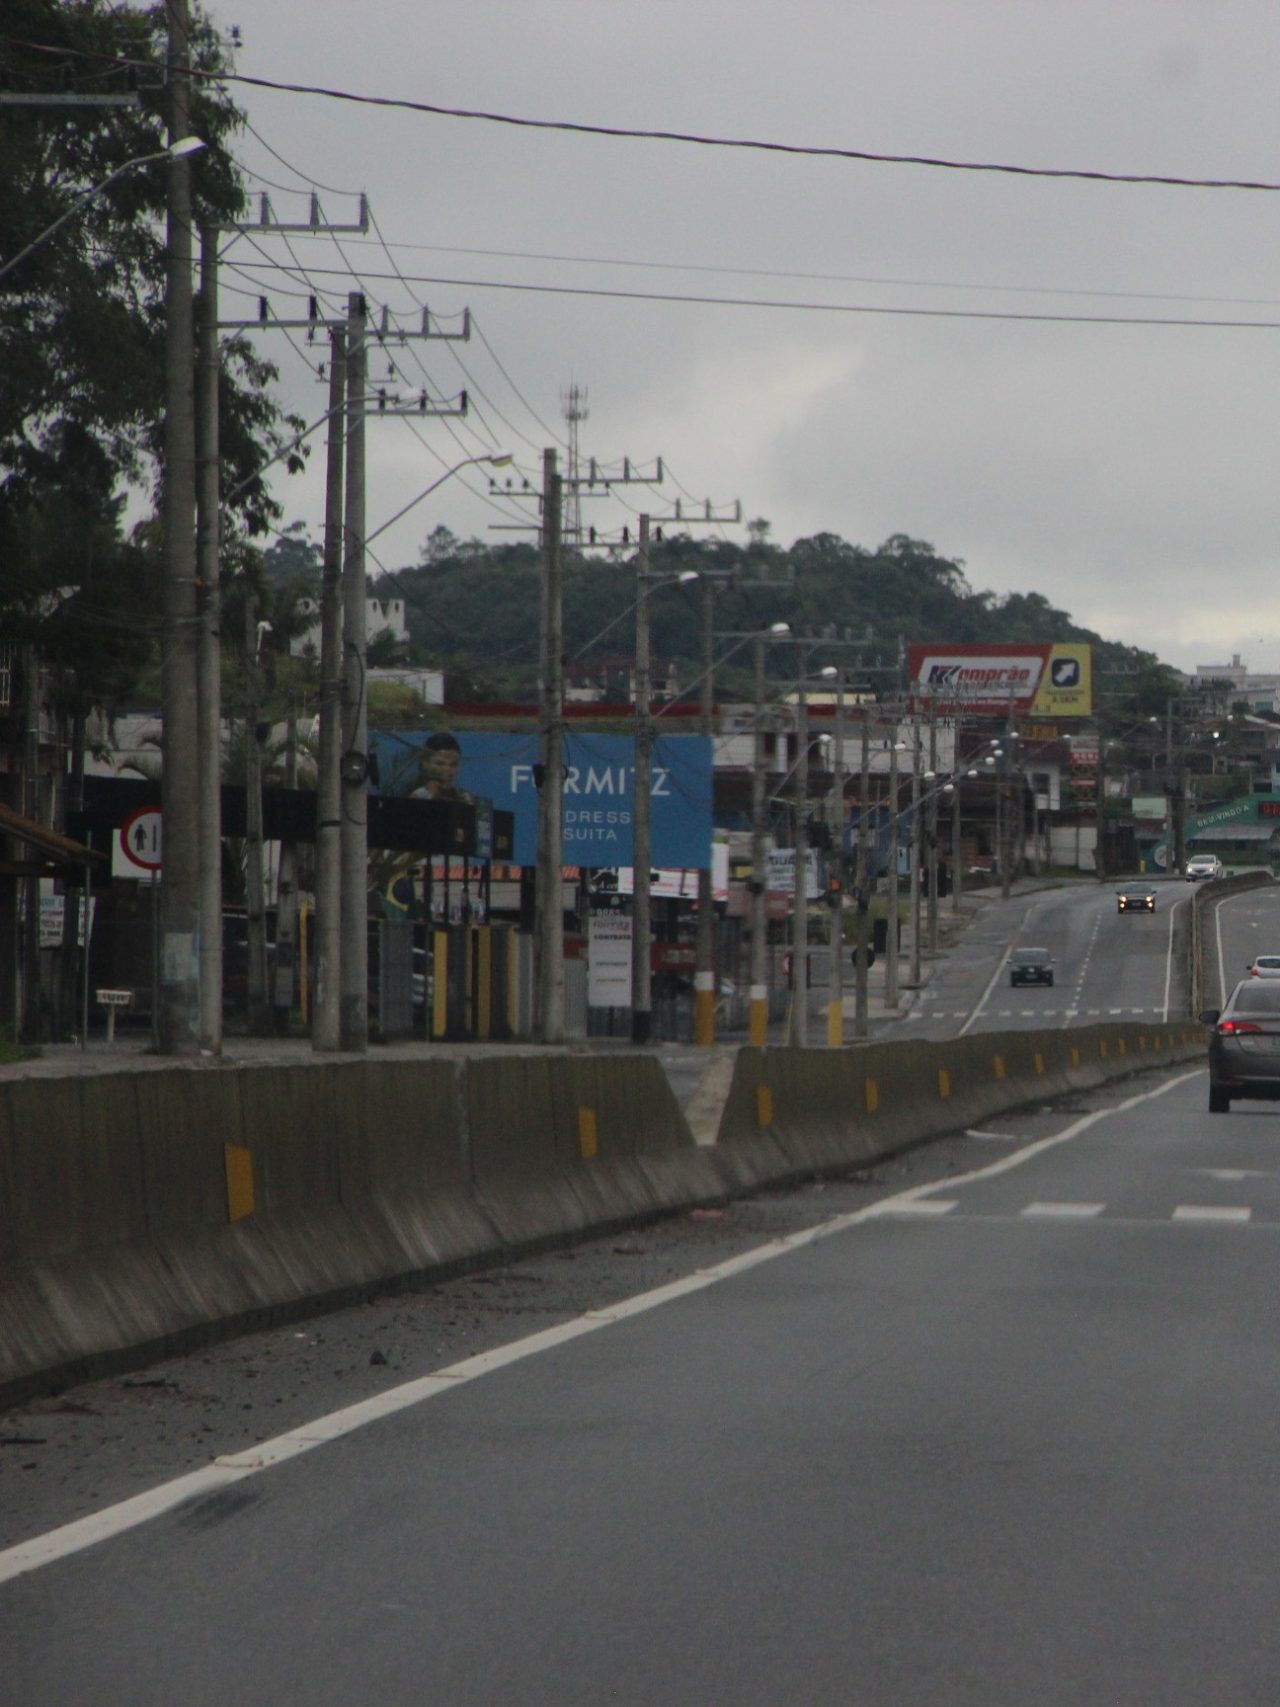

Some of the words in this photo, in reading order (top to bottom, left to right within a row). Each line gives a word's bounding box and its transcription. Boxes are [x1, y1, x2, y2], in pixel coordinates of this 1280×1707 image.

[511, 765, 670, 796] FRMIZ
[565, 811, 631, 824] DRESS
[562, 828, 617, 841] SUITA
